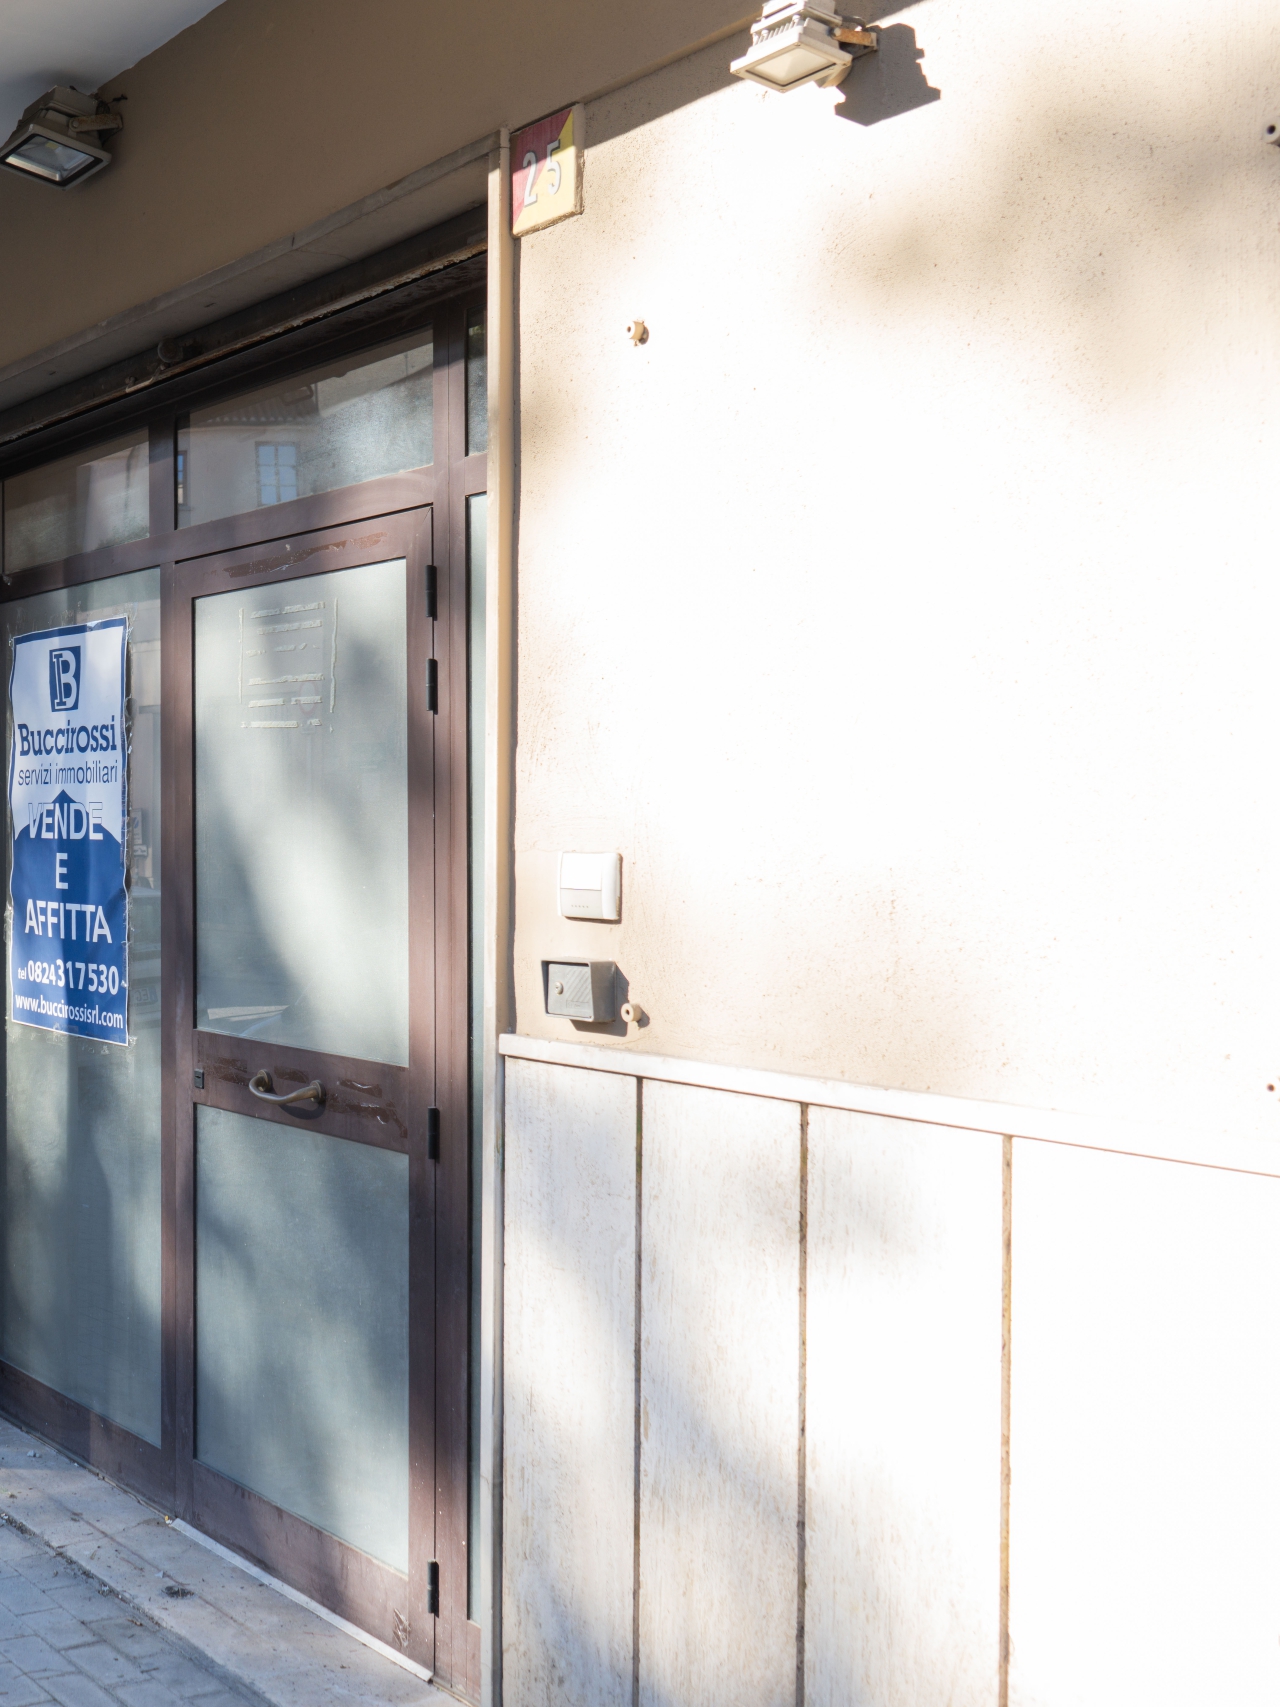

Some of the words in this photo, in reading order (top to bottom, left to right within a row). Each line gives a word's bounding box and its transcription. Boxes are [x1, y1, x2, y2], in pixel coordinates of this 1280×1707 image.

[523, 139, 561, 207] 25
[18, 714, 117, 757] Buccirossi
[18, 762, 53, 786] servizi
[55, 759, 118, 785] immobiliari
[28, 801, 104, 840] VENDE
[55, 851, 69, 890] E
[24, 898, 112, 944] AFFITTA
[18, 966, 26, 980] tel
[15, 993, 123, 1029] www.buccirossisrl.com
